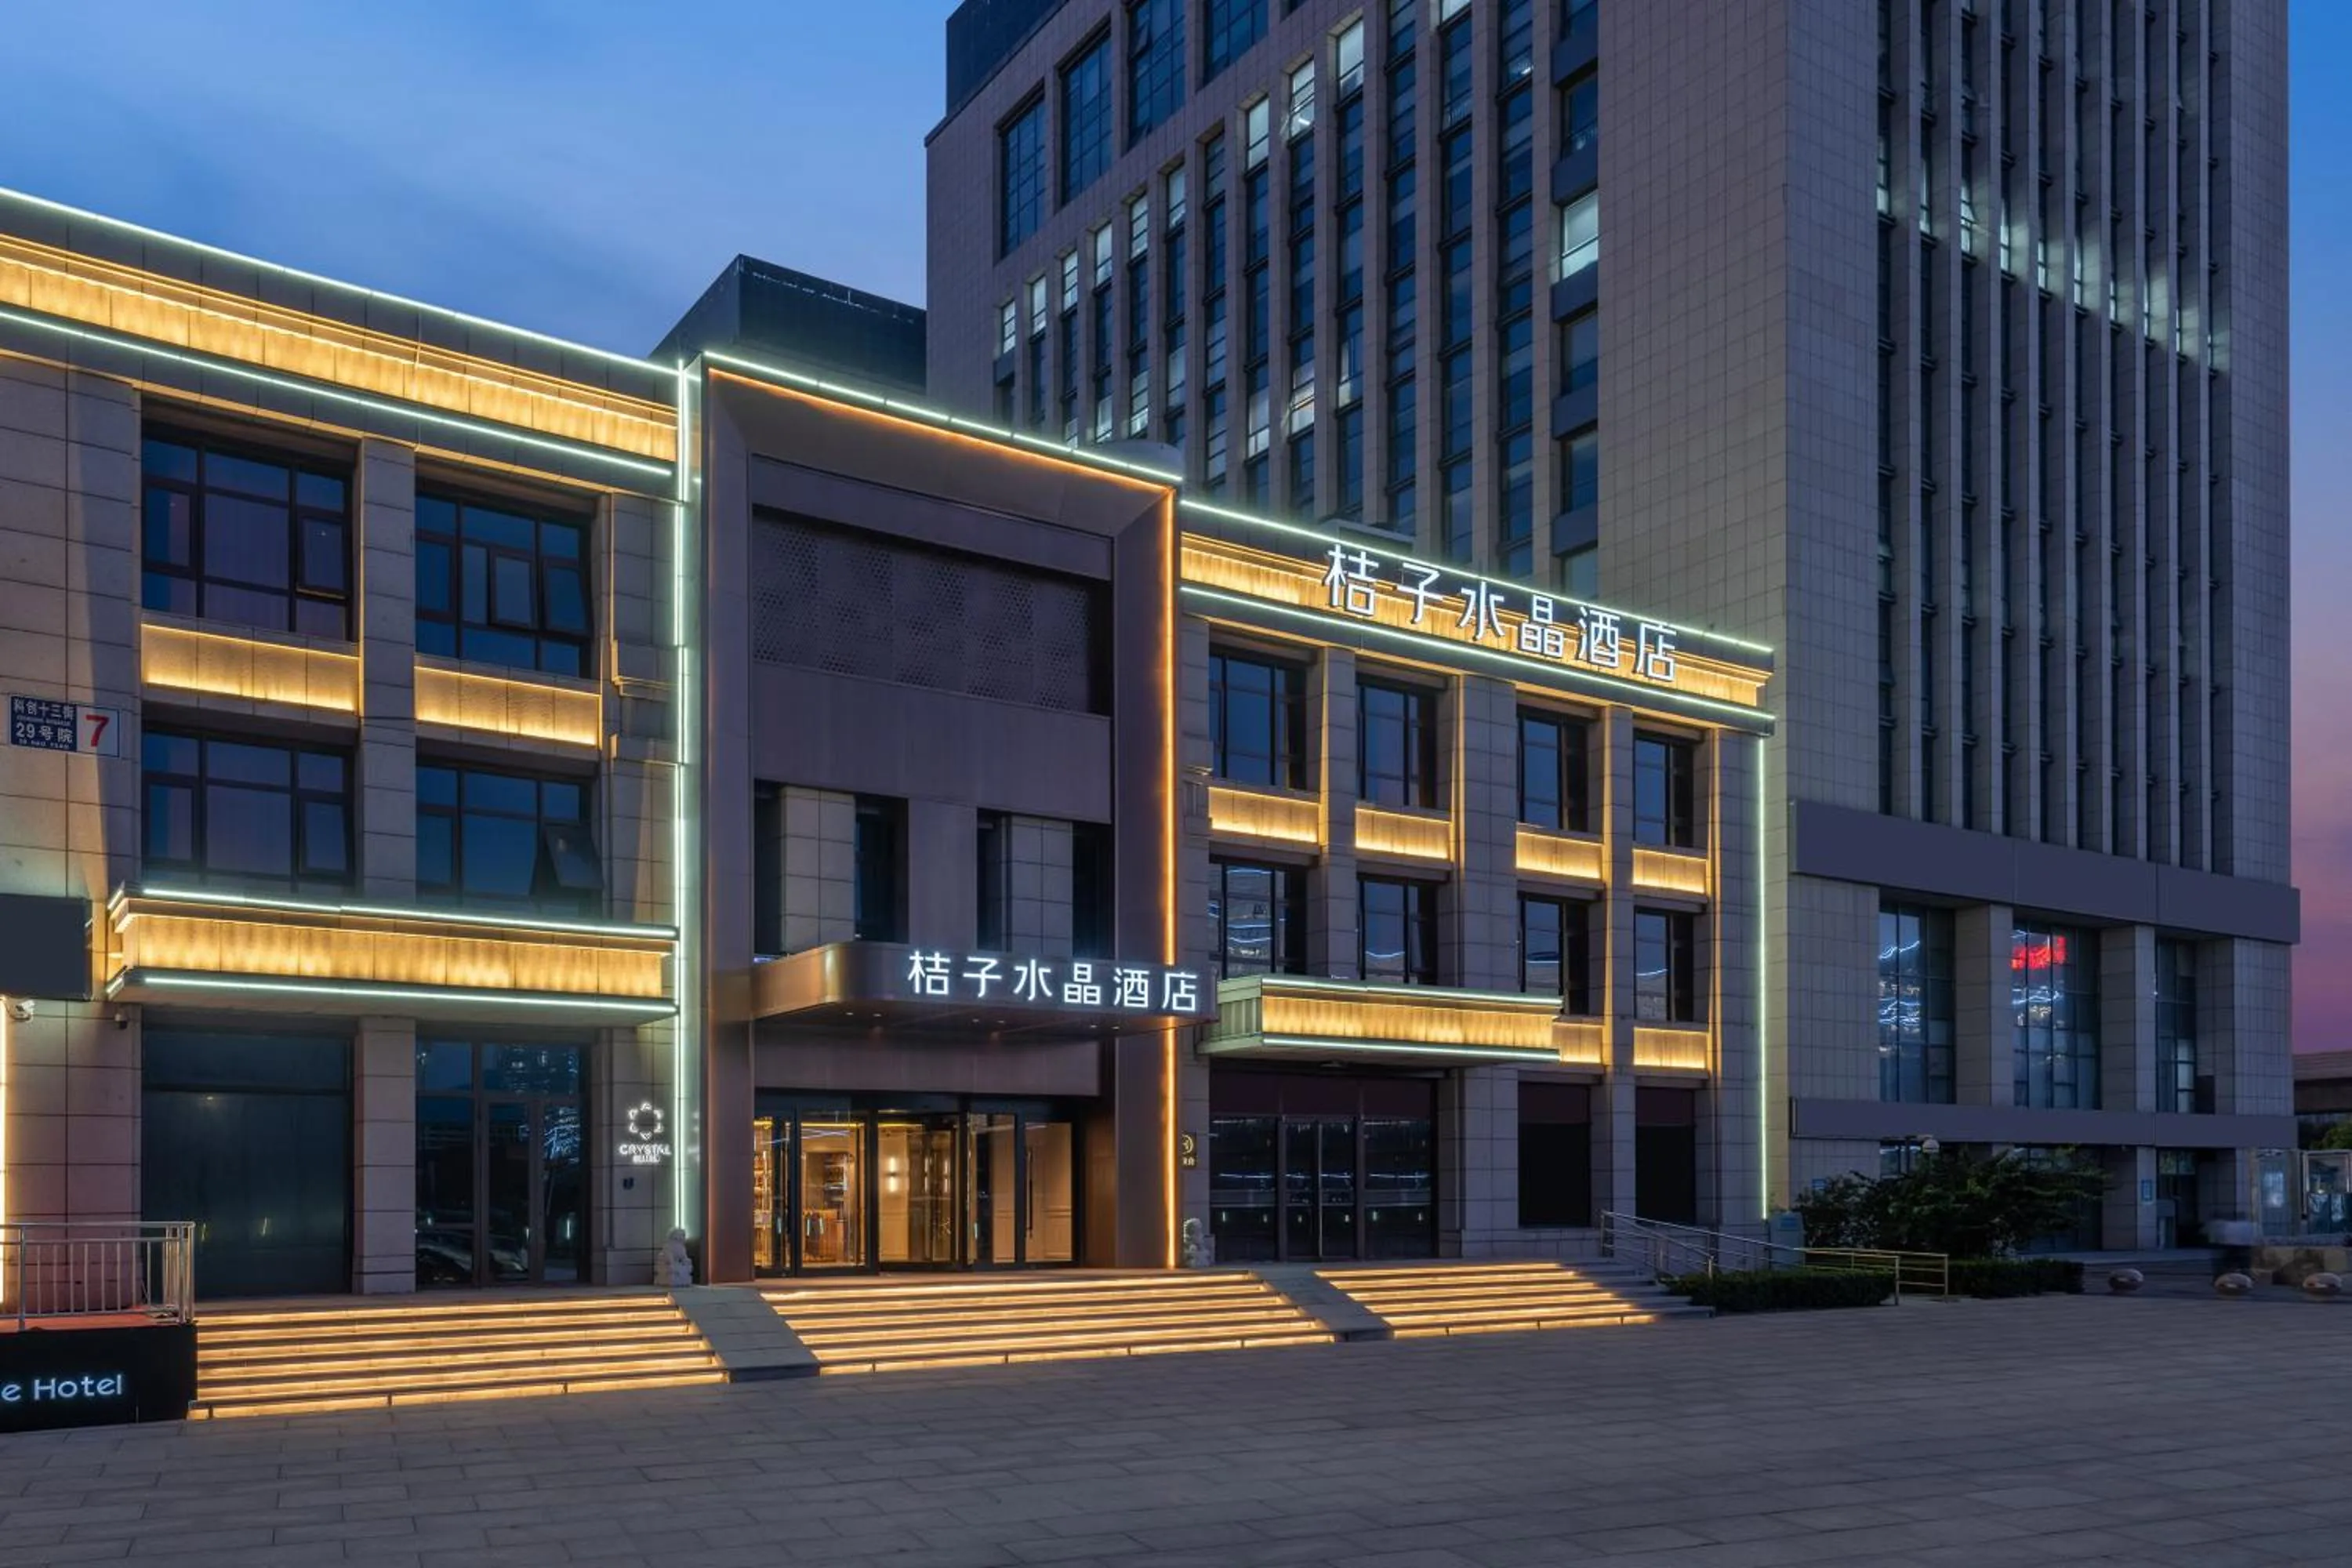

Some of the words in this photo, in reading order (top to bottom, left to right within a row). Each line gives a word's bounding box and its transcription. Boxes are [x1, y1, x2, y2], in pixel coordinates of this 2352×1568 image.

[1323, 544, 1676, 681] 桔子水晶酒店
[16, 722, 73, 743] 29号院
[85, 714, 110, 747] 7
[907, 950, 1198, 1011] 桔子水晶酒店
[34, 1374, 122, 1400] Hotel
